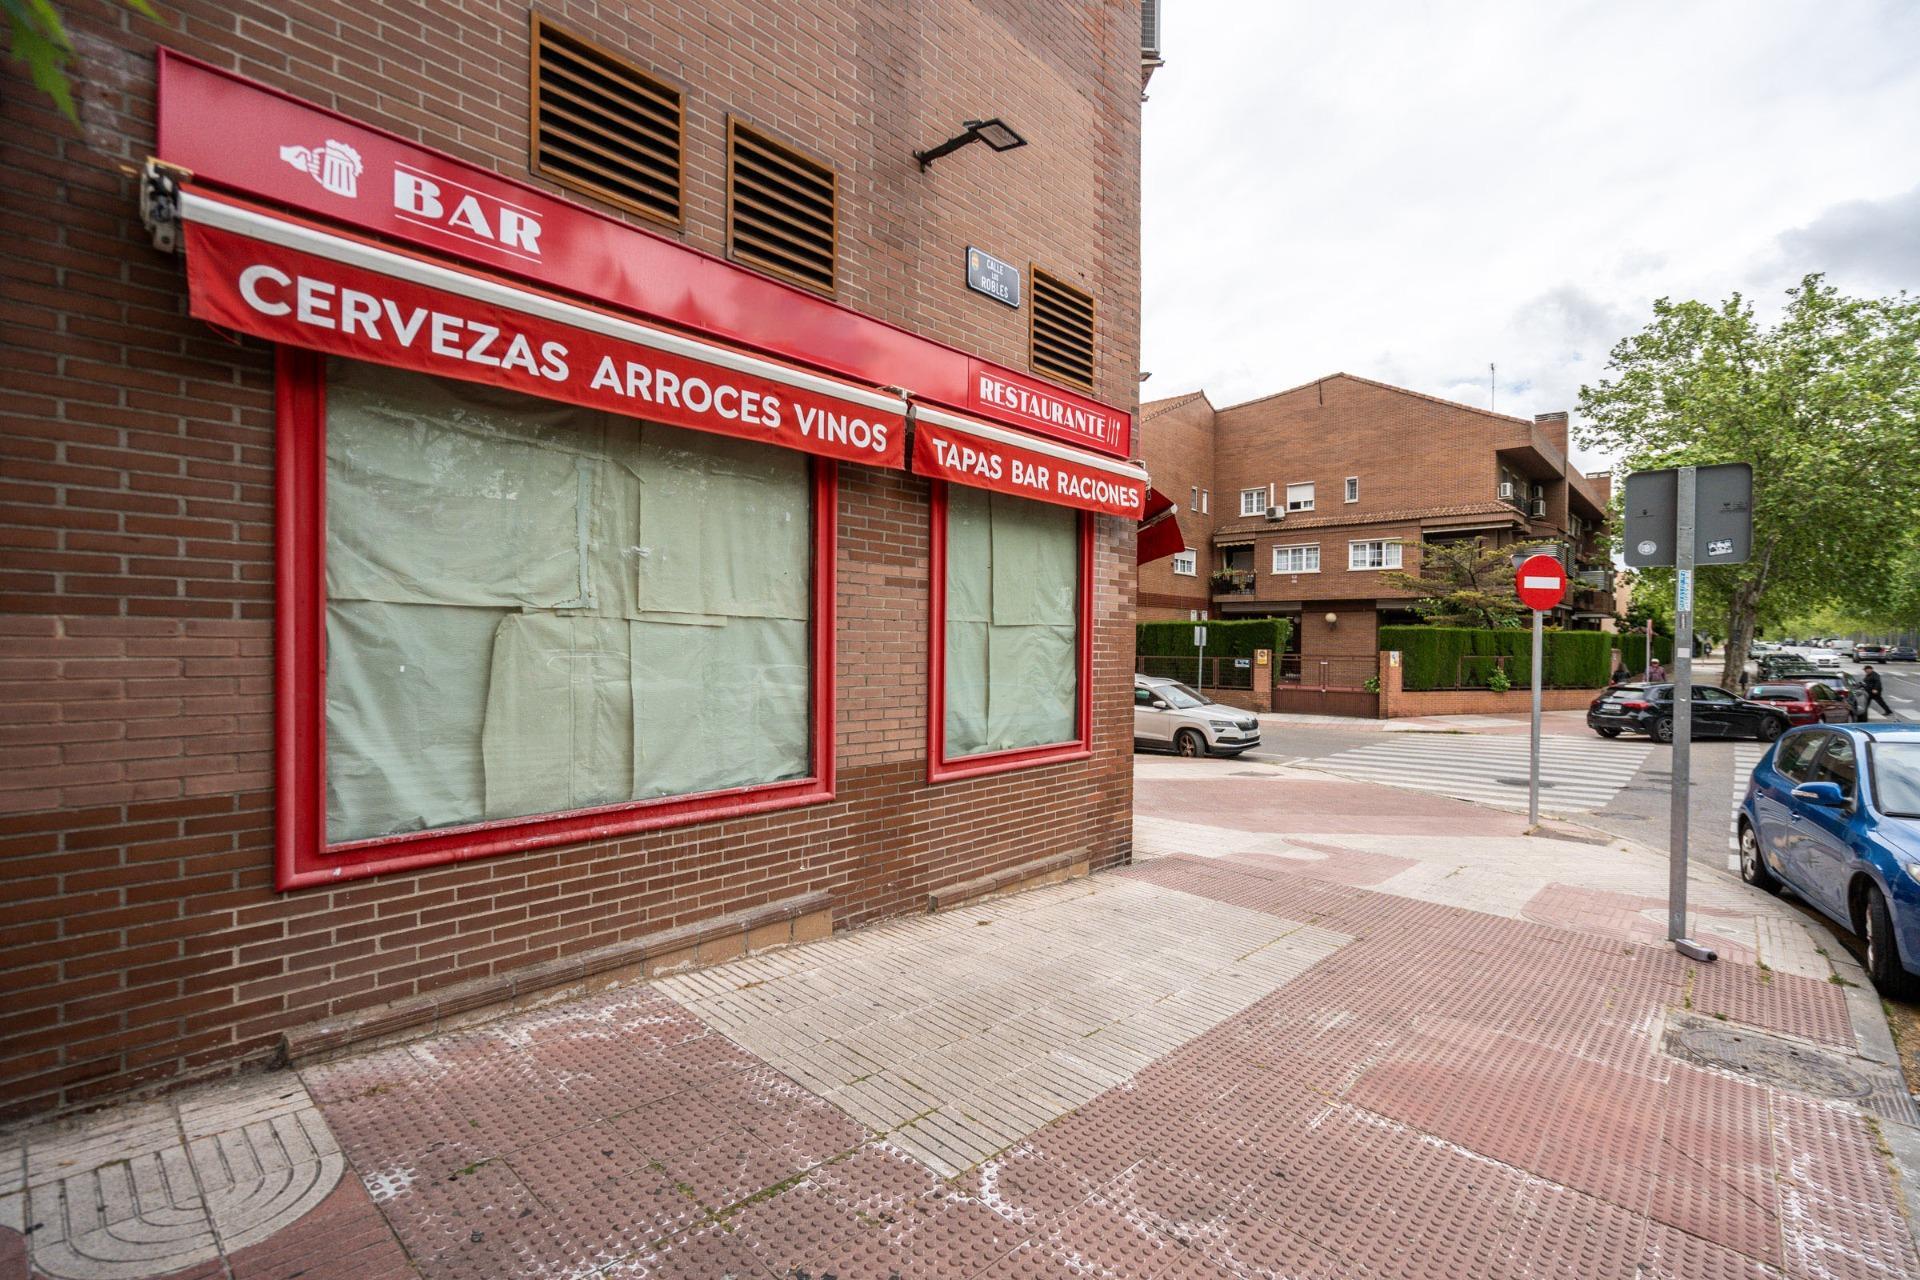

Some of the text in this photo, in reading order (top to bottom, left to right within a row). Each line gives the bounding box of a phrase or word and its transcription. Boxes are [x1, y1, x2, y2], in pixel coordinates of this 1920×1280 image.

[394, 169, 542, 254] BAR
[981, 275, 1009, 298] ROBLES
[986, 259, 1004, 275] CALLE
[238, 264, 888, 452] CERVEZAS ARROCES VINOS
[979, 376, 1106, 439] RESTAURANTE
[932, 438, 1139, 508] TAPAS BAR RACIONES
